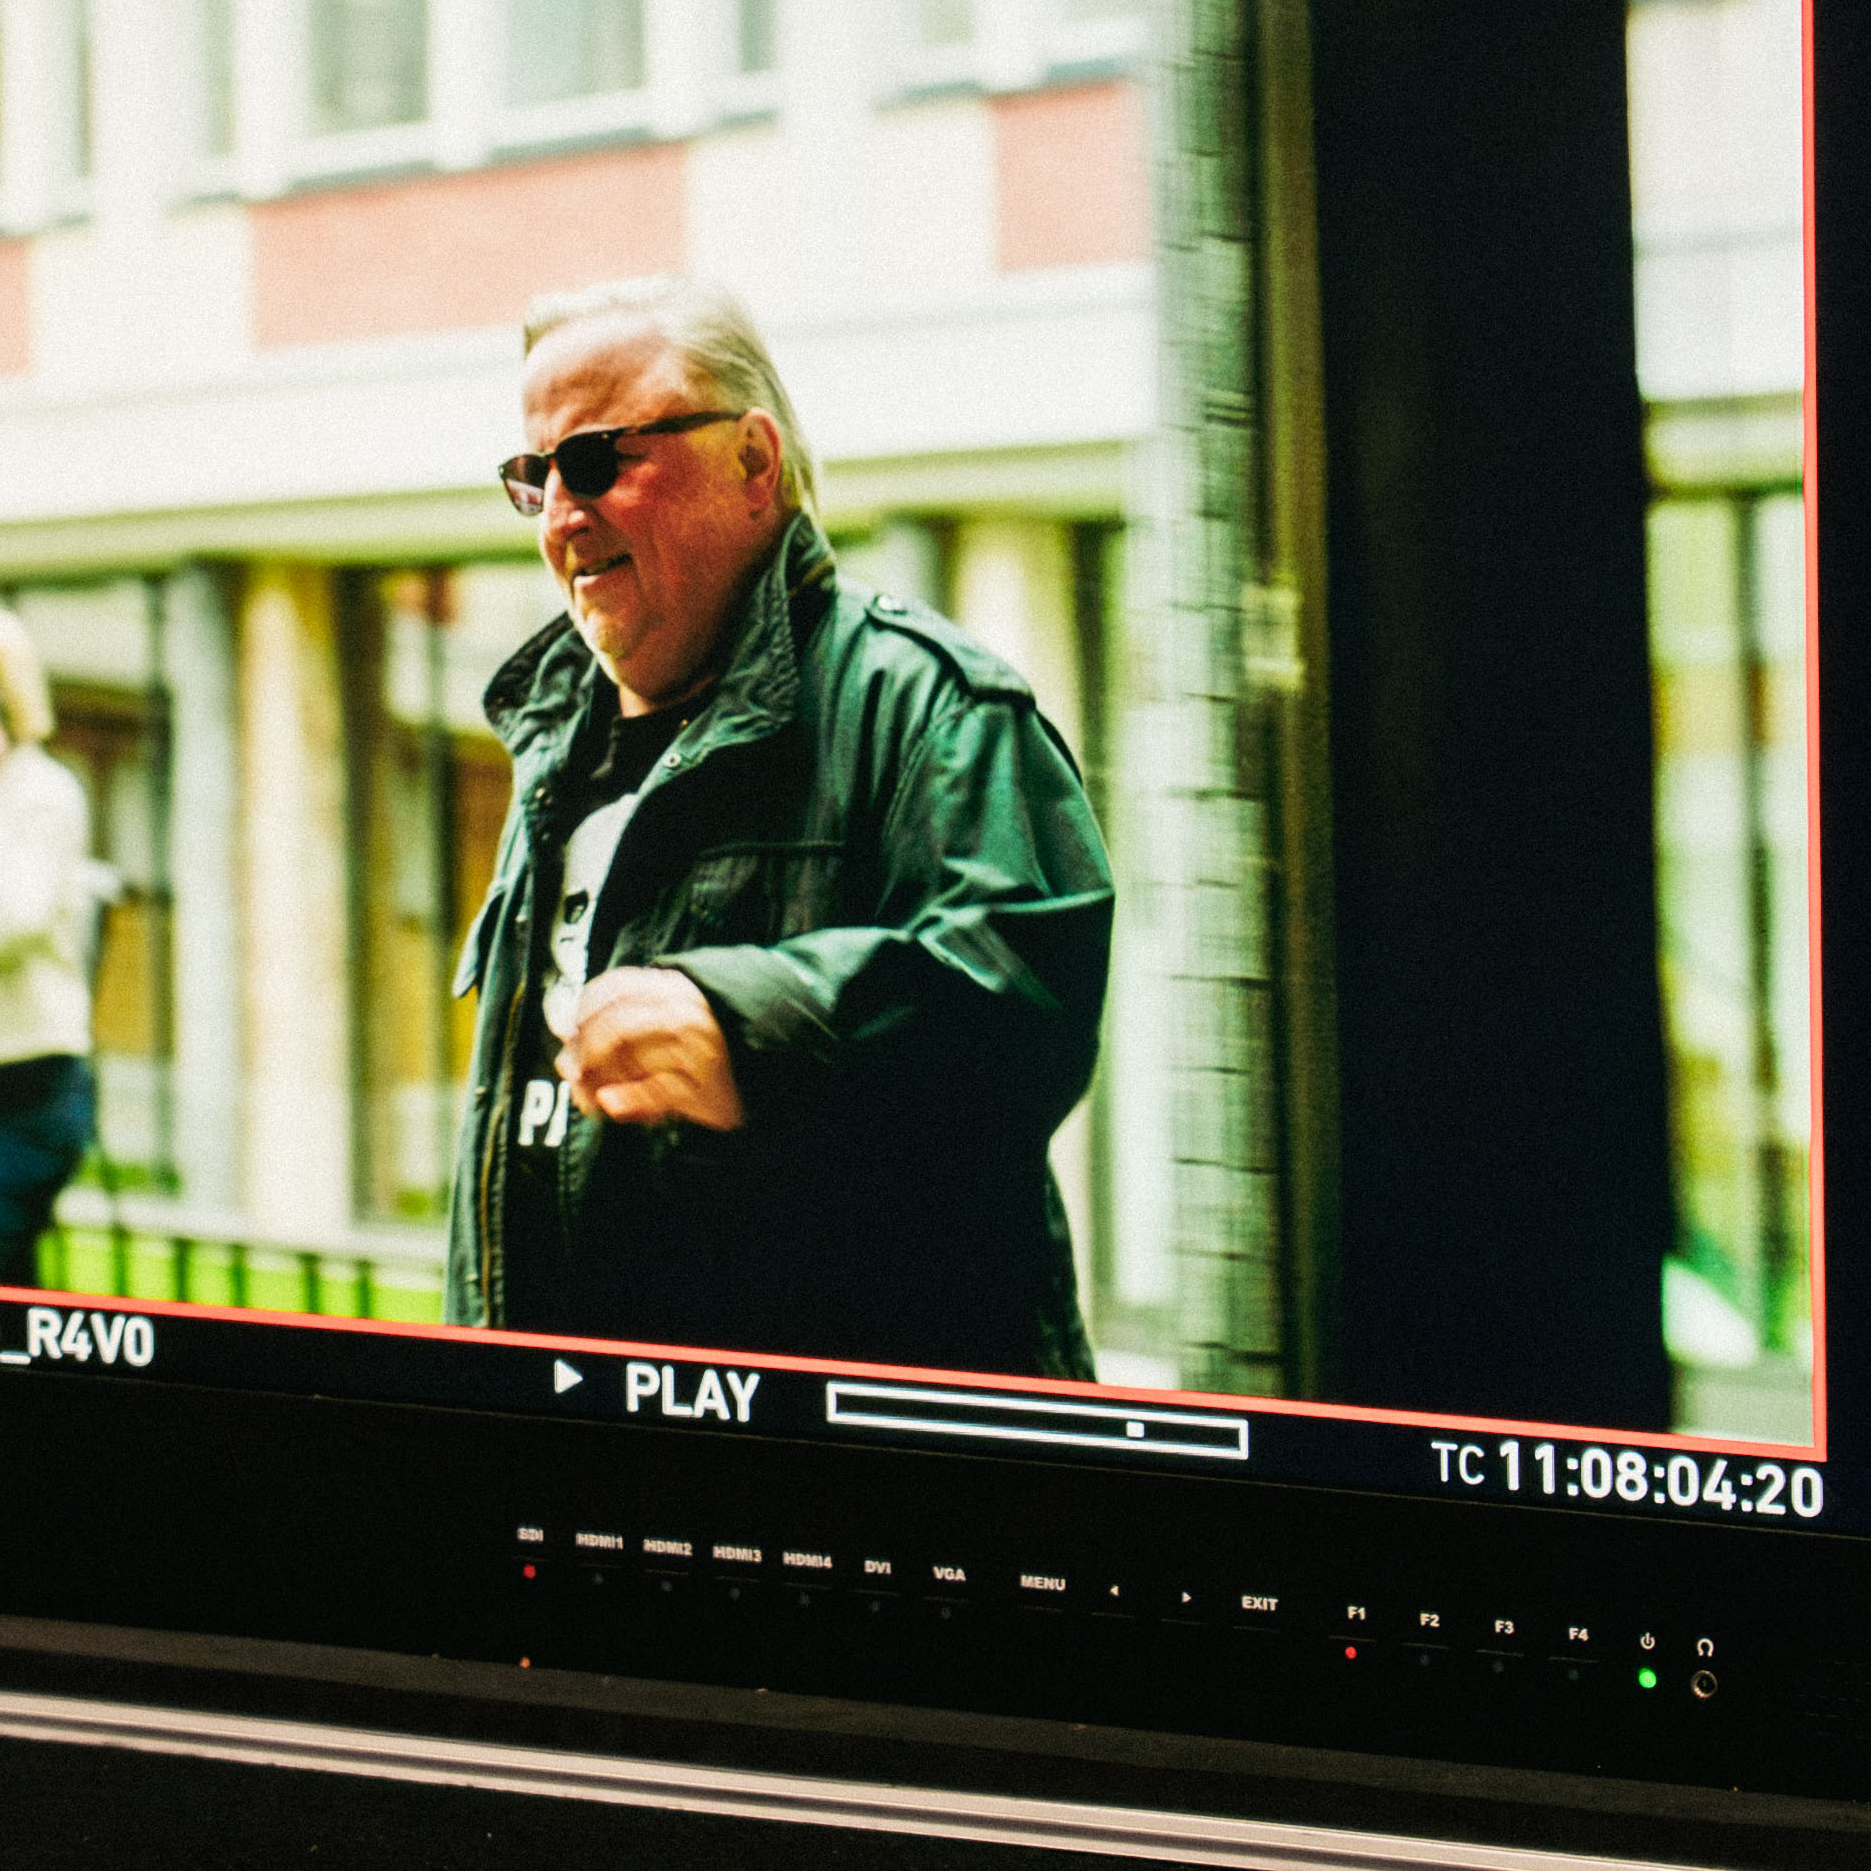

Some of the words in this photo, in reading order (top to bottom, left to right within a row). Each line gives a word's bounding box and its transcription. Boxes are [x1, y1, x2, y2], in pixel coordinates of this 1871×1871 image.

[625, 1361, 761, 1423] PLAY
[1430, 1441, 1485, 1486] TC
[1499, 1440, 1824, 1518] 11:08:04:20
[575, 1532, 625, 1550] HDMI1
[643, 1538, 693, 1557] HDMI2
[712, 1544, 763, 1564] HDMI3
[782, 1551, 833, 1570] HDMI4
[864, 1559, 892, 1575] DVI
[933, 1565, 967, 1582] VGA
[1020, 1574, 1066, 1592] MENU
[1241, 1595, 1279, 1611] EXIT
[1347, 1605, 1366, 1620] F1
[1420, 1612, 1440, 1628] F2
[1494, 1619, 1515, 1635] F3
[1568, 1626, 1589, 1642] F4
